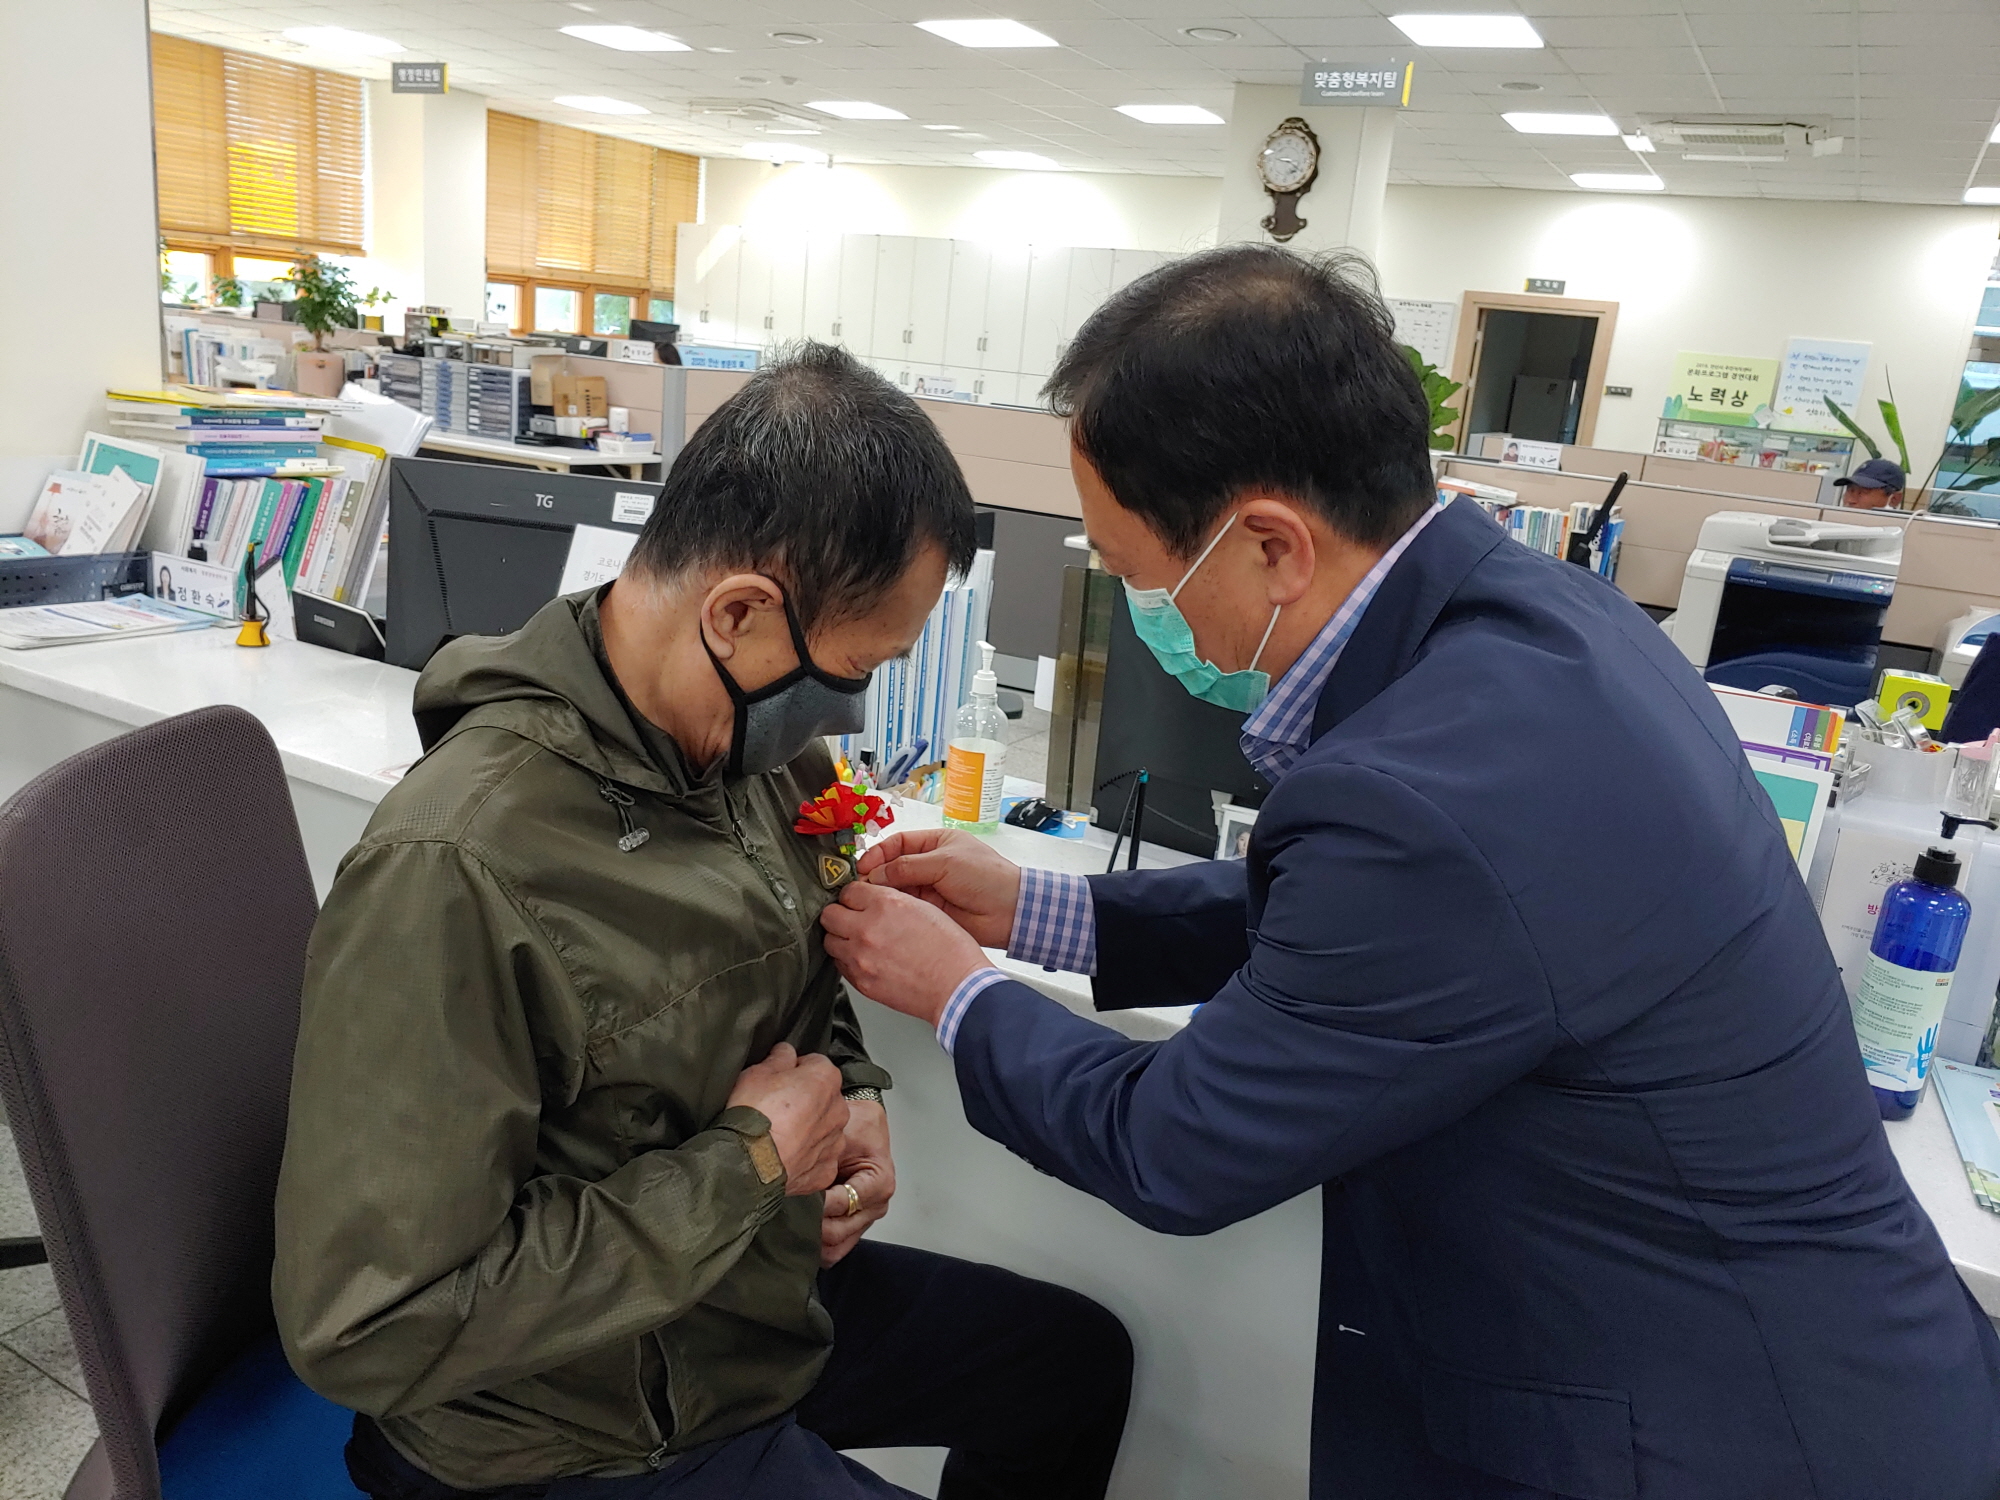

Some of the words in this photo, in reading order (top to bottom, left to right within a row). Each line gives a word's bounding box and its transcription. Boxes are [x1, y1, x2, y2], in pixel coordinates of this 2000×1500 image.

[1314, 71, 1398, 89] 맞춤형복지팀
[535, 494, 554, 508] TG
[597, 557, 626, 570] 코로나
[583, 570, 606, 583] 경기도
